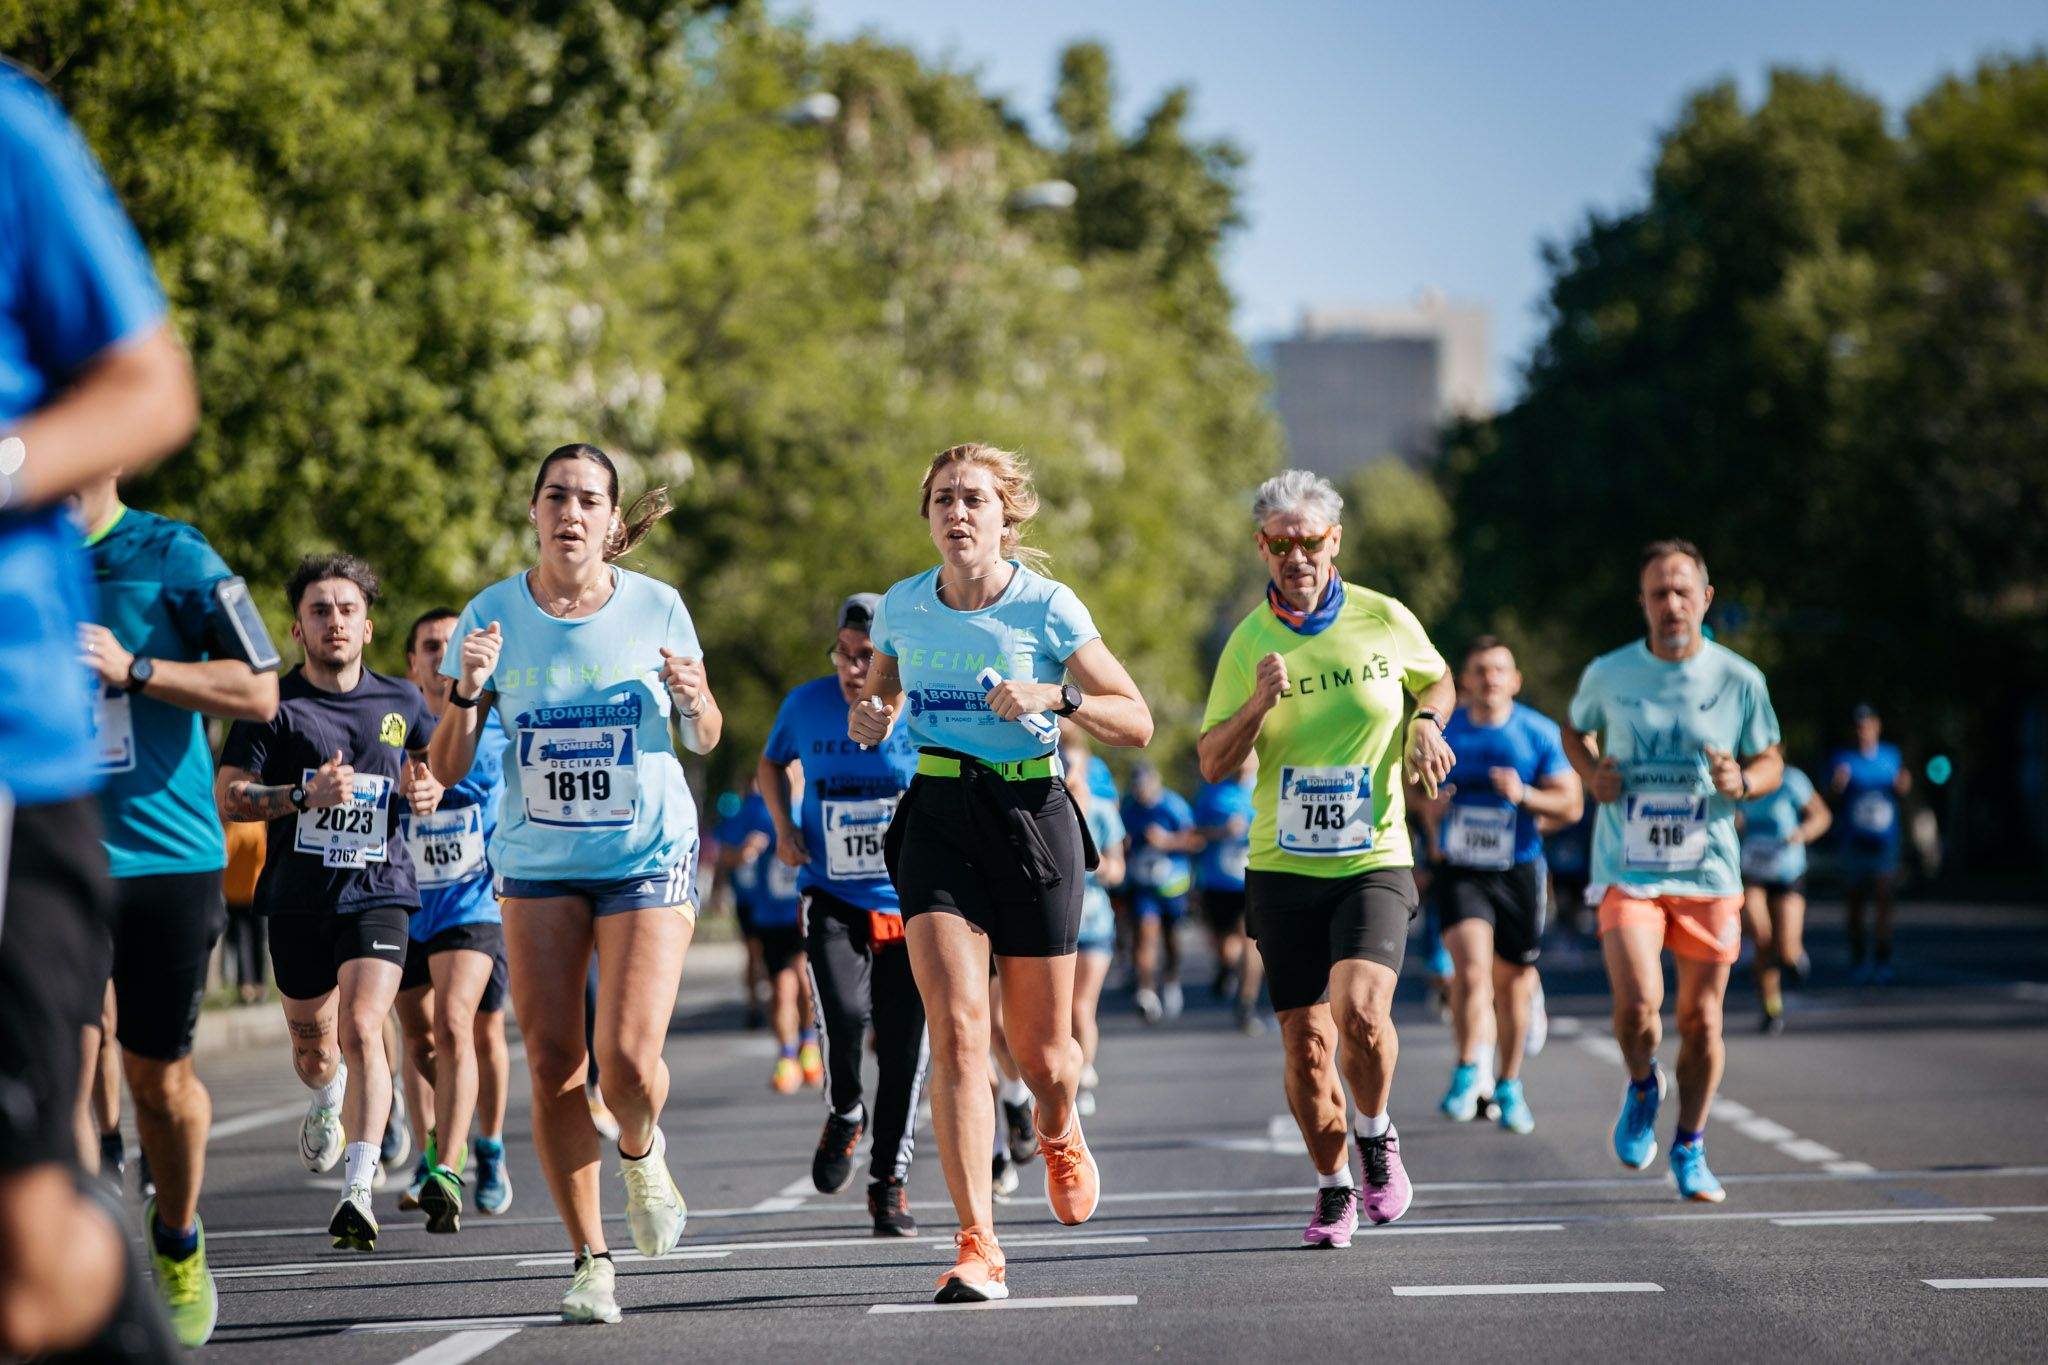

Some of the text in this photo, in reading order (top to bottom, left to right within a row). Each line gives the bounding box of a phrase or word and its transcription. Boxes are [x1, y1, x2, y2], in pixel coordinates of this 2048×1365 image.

[541, 704, 639, 721] BOMBEROS
[556, 741, 612, 752] BOMBEROS
[551, 758, 611, 769] DECIMAS
[545, 770, 610, 801] 1819
[1302, 793, 1352, 801] DECIMAS
[316, 806, 374, 834] 2023
[1302, 804, 1345, 830] 743
[329, 849, 357, 863] 2762
[425, 842, 462, 866] 453
